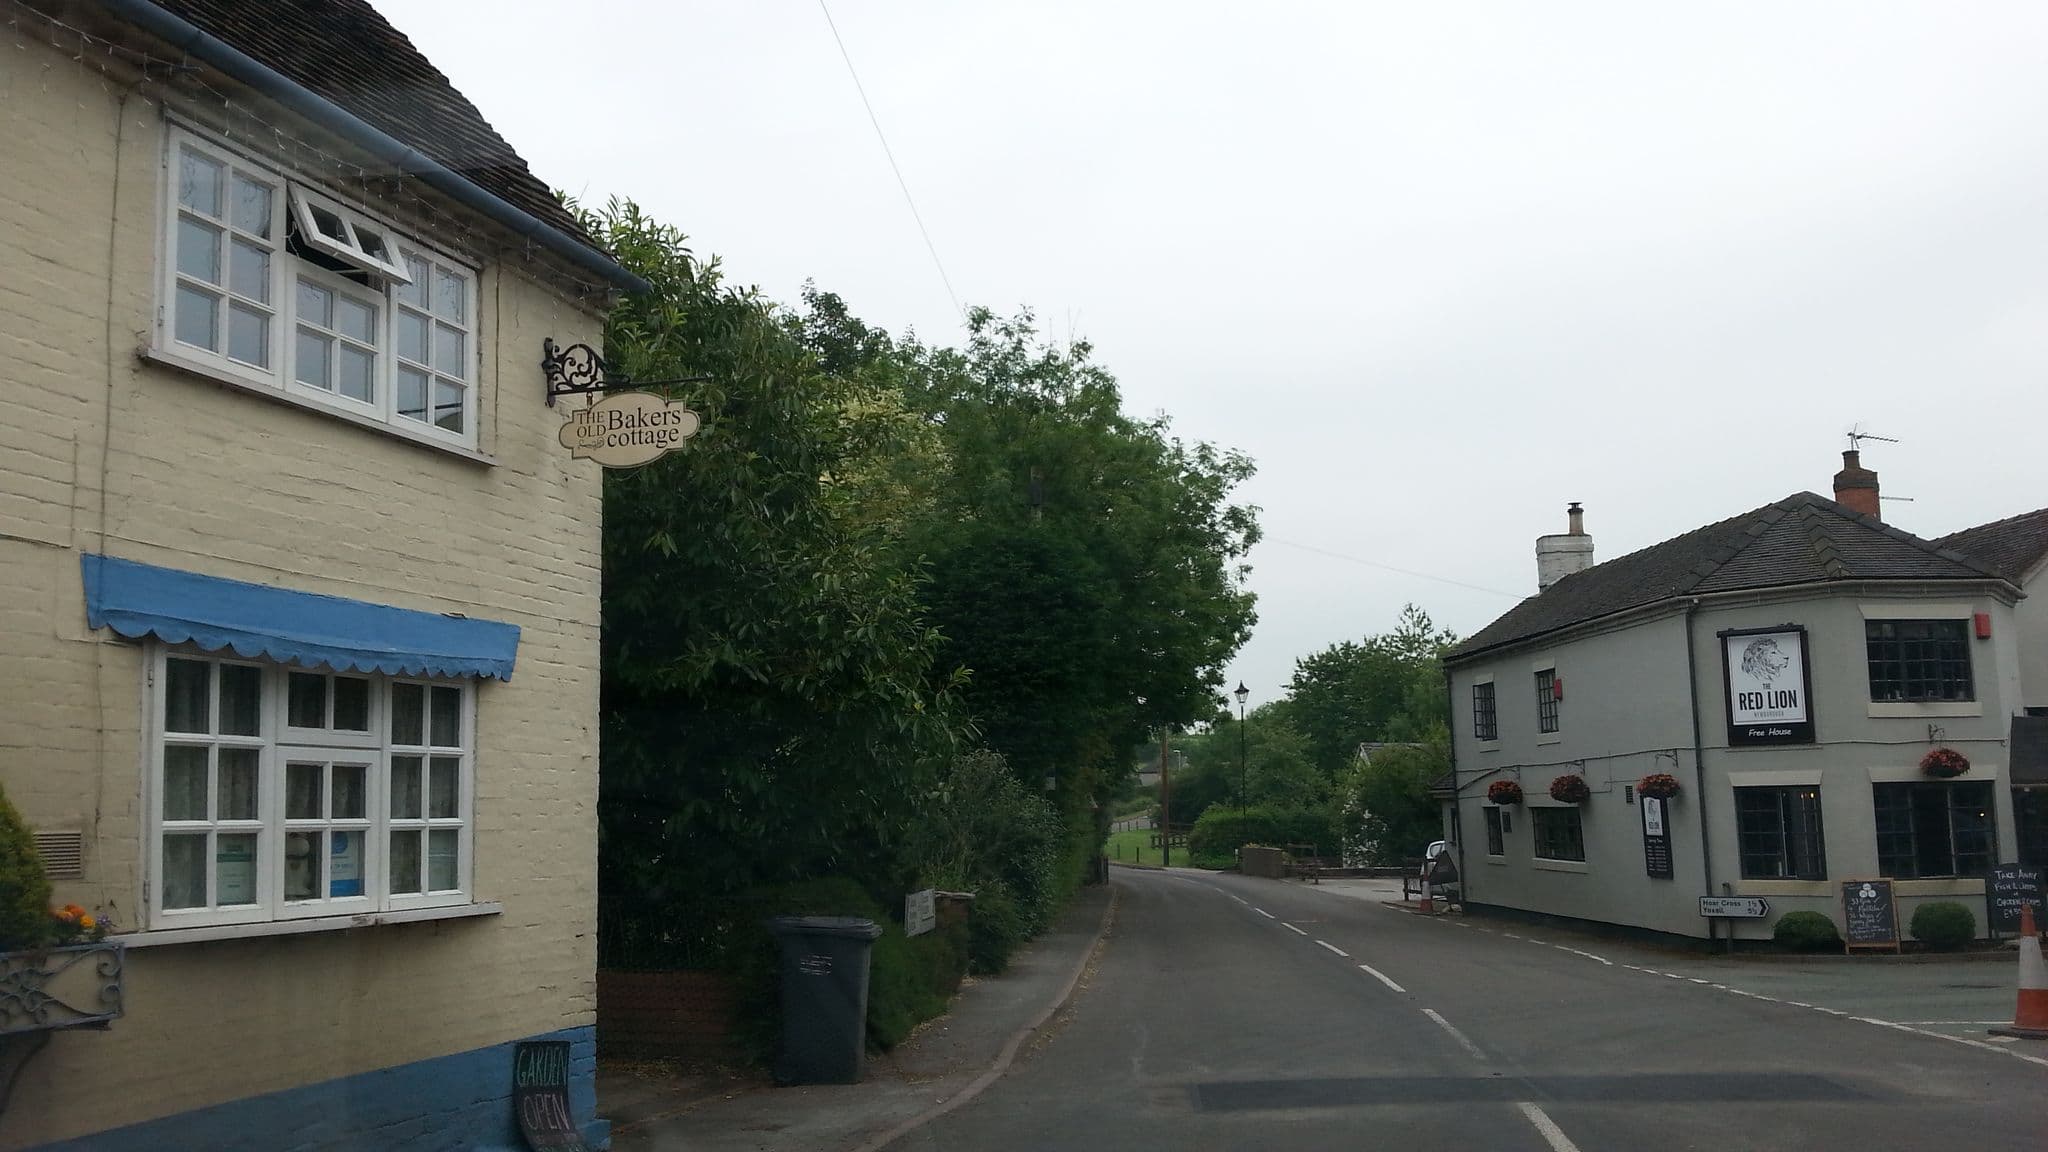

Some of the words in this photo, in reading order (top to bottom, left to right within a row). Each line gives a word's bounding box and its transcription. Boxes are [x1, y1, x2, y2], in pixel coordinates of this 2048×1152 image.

[577, 411, 605, 424] THE
[607, 407, 681, 430] Bakers
[576, 424, 606, 438] OLD
[607, 427, 680, 448] cottage
[1739, 692, 1763, 710] RED
[1767, 690, 1798, 709] LION
[1748, 728, 1765, 737] Free
[1768, 727, 1792, 736] House
[1721, 899, 1741, 907] Cross
[517, 1046, 568, 1087] GARDEN
[523, 1093, 570, 1130] OPEN
